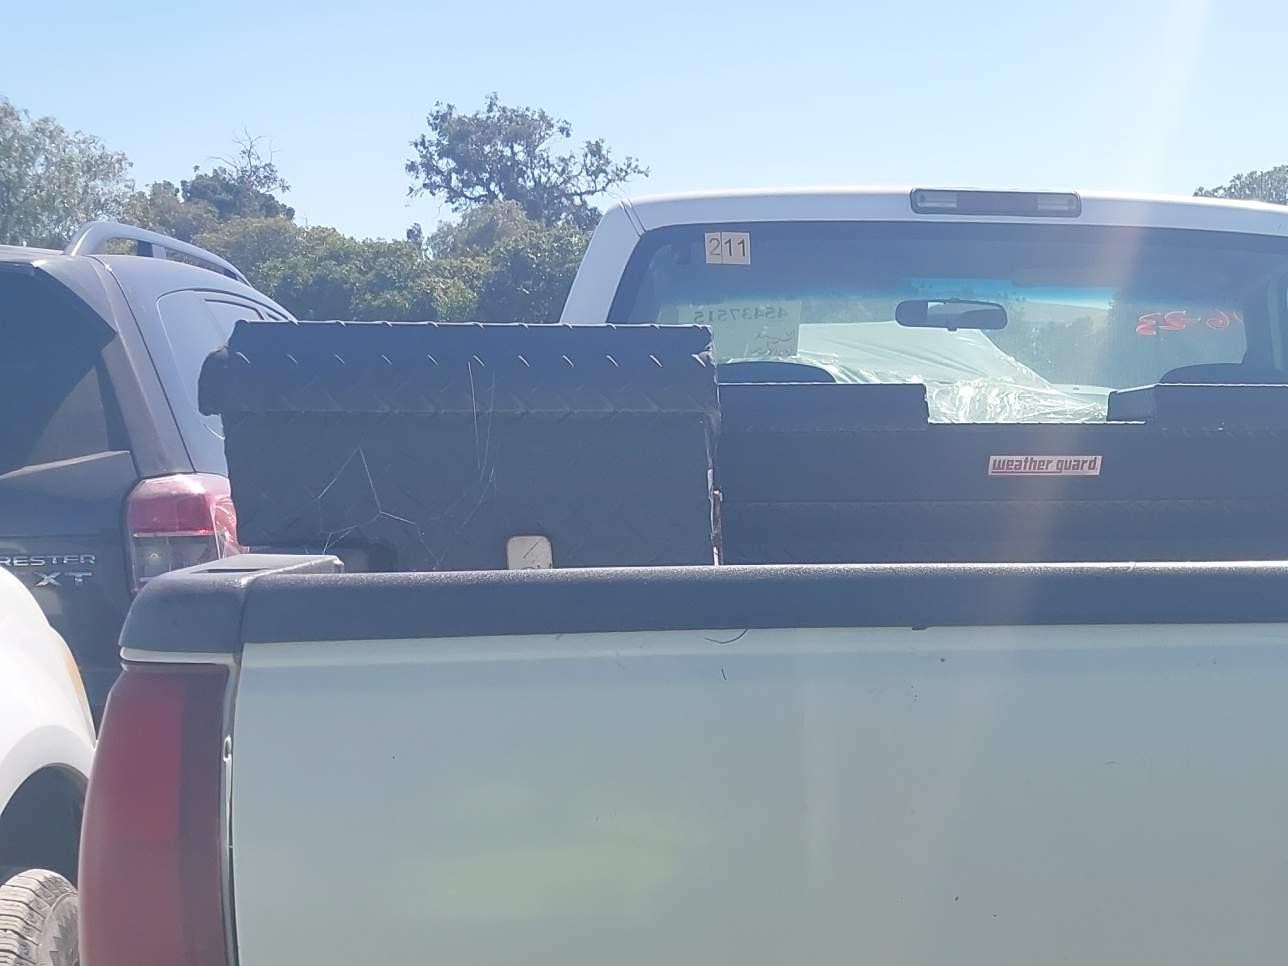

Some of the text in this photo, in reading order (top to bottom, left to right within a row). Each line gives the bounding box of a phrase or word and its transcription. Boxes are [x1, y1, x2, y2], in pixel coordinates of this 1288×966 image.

[709, 237, 746, 257] 211
[992, 457, 1097, 474] weather guard
[33, 571, 93, 587] XT
